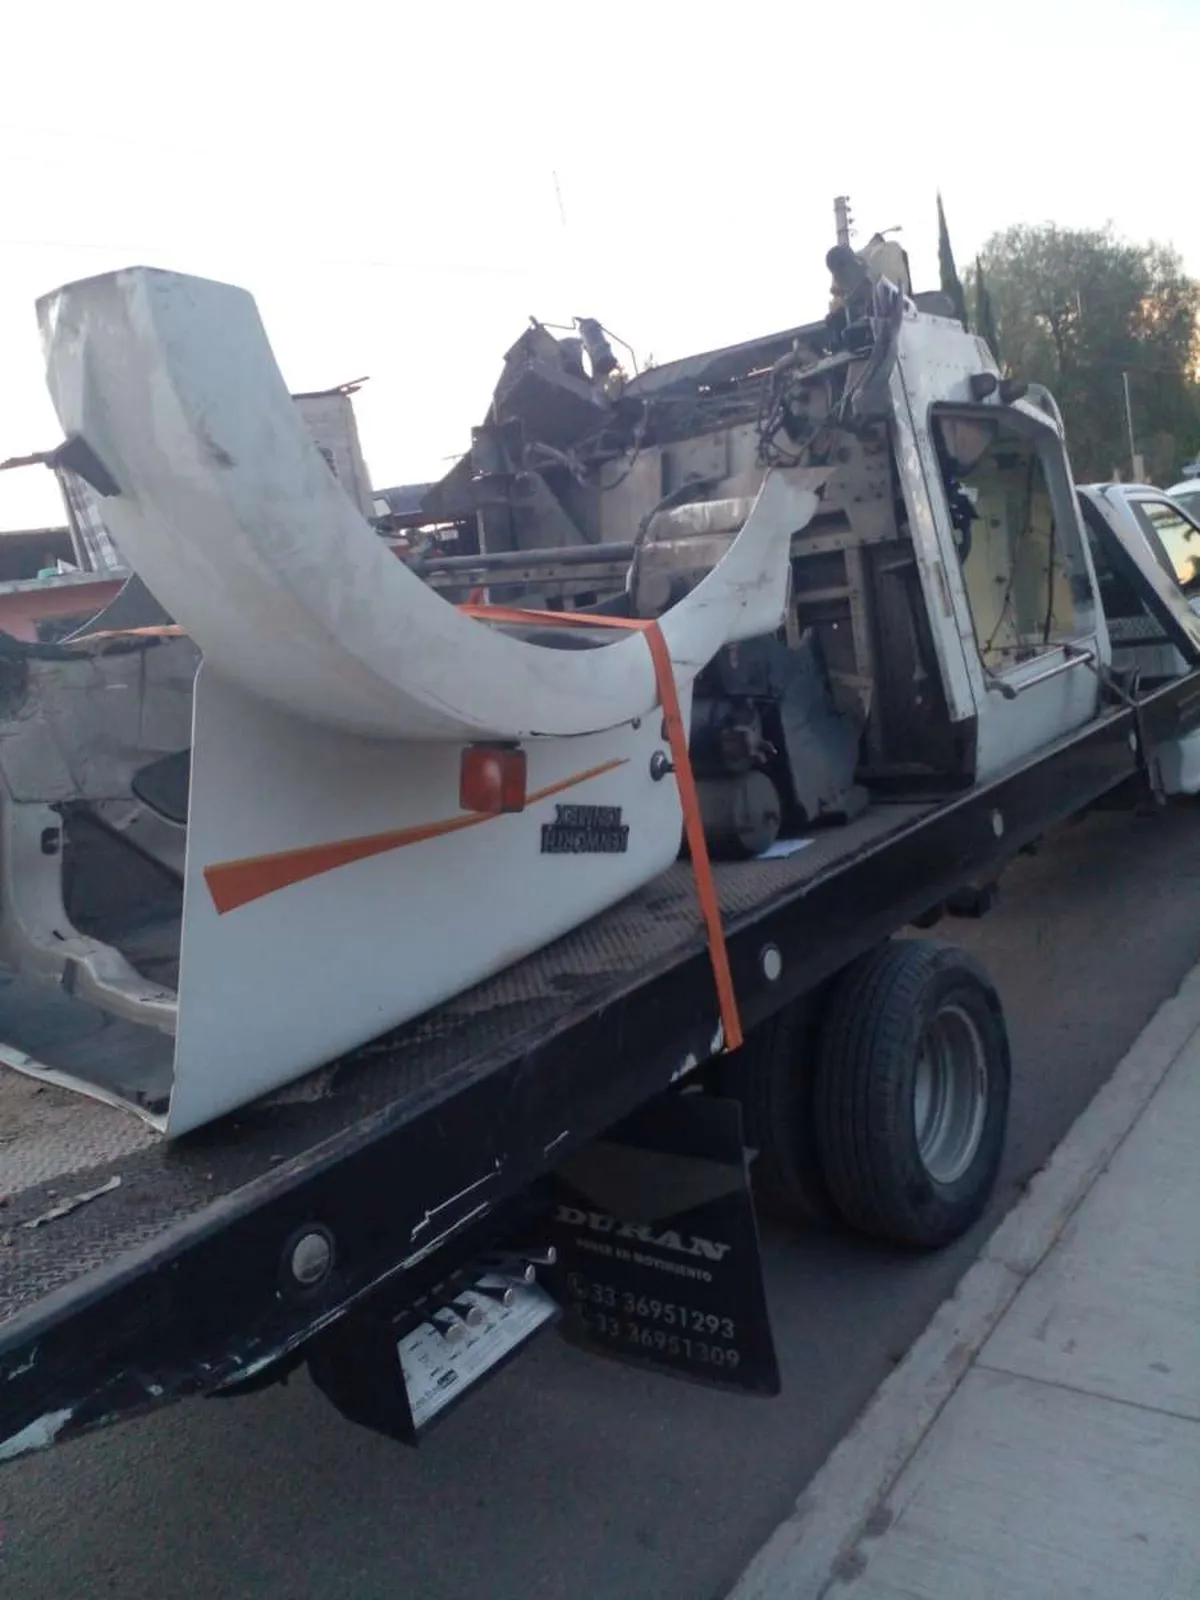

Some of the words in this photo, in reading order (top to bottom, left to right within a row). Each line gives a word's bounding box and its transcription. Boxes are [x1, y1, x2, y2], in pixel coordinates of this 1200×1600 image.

[541, 824, 629, 854] KENWORTH
[591, 1283, 617, 1307] 33
[622, 1292, 735, 1339] 36951293
